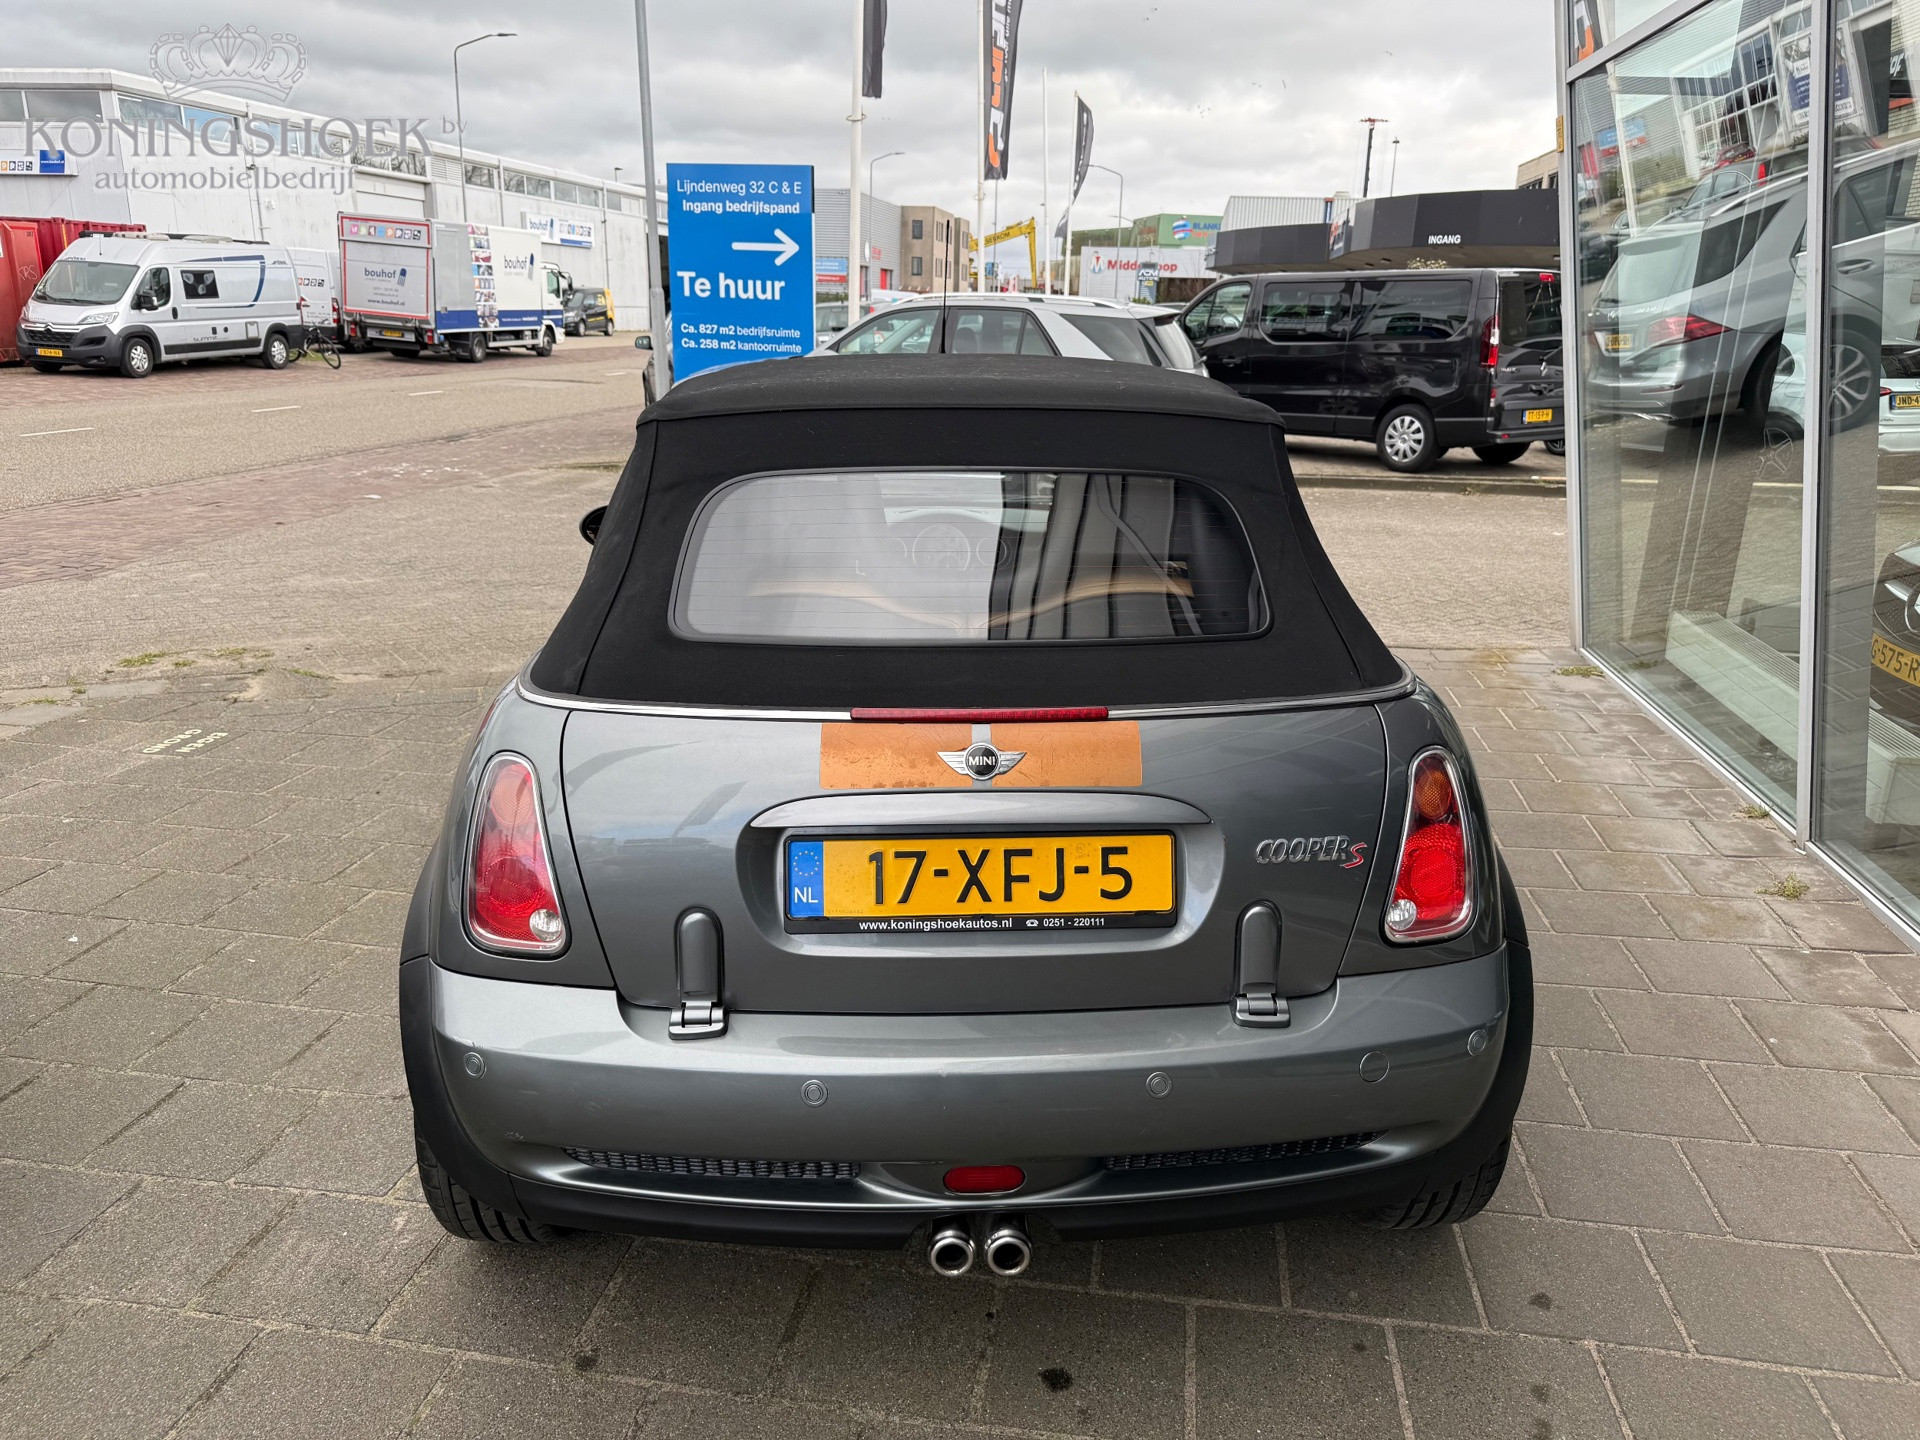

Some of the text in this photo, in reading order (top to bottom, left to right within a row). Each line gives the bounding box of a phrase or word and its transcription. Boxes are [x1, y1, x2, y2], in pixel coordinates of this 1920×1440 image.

[677, 180, 802, 197] Lijndenweg 32 C & E
[682, 200, 800, 216] Ingang bedrijfspand
[1428, 235, 1461, 245] INGANG
[364, 267, 396, 279] bouhof
[1107, 259, 1177, 272] Middeoop
[677, 271, 785, 301] Te huur
[681, 323, 800, 339] Ca. 827 m2 bedrijfsruimte
[682, 338, 802, 353] Ca. 258 m2 kantoorruimte
[1871, 638, 1920, 683] G-575-R
[143, 728, 202, 753] GROND
[175, 732, 229, 753] EIGEN
[968, 755, 996, 766] MINI
[1256, 835, 1350, 864] COOPER
[794, 846, 1132, 905] NL 17-XFJ-5
[859, 917, 1013, 932] www.koningshoekautos.nl
[1043, 917, 1065, 927] 0251
[1073, 917, 1105, 927] 220111
